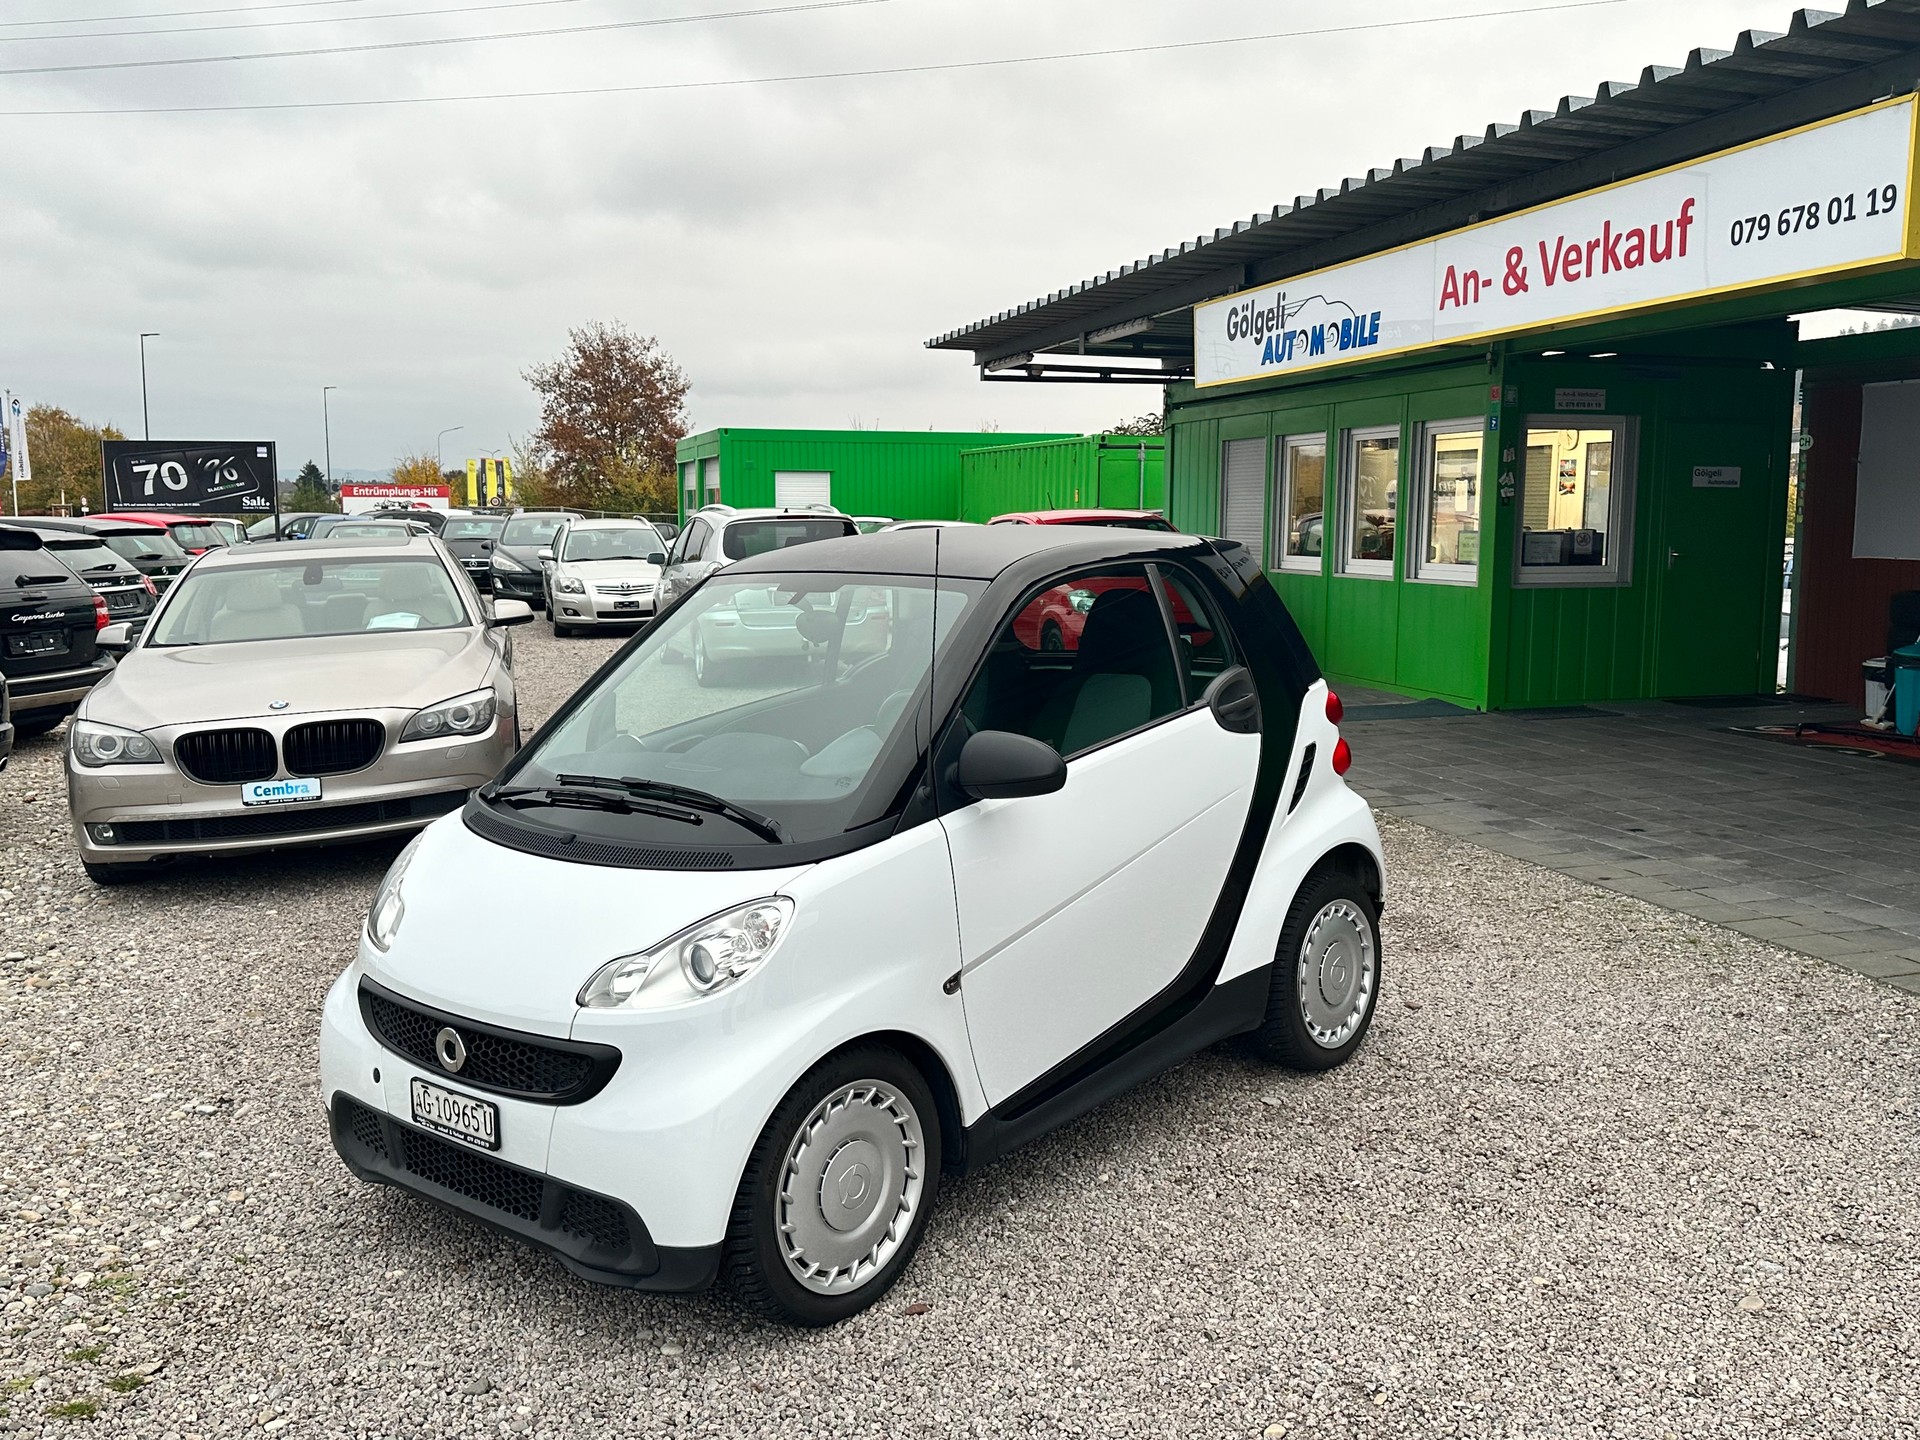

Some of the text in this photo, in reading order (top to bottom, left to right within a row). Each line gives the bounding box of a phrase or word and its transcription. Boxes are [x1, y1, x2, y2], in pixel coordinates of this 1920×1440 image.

[1730, 183, 1898, 246] 079 678 01 19
[1439, 197, 1696, 311] An- & Verkauf
[1226, 292, 1287, 346] Gölgeli
[1799, 437, 1811, 447] CH
[132, 461, 188, 496] 70
[1694, 468, 1722, 478] Gölgeli
[353, 487, 438, 498] Entrümplungs-Hit
[11, 611, 65, 624] Cayenne turbo
[253, 782, 310, 797] Cembra
